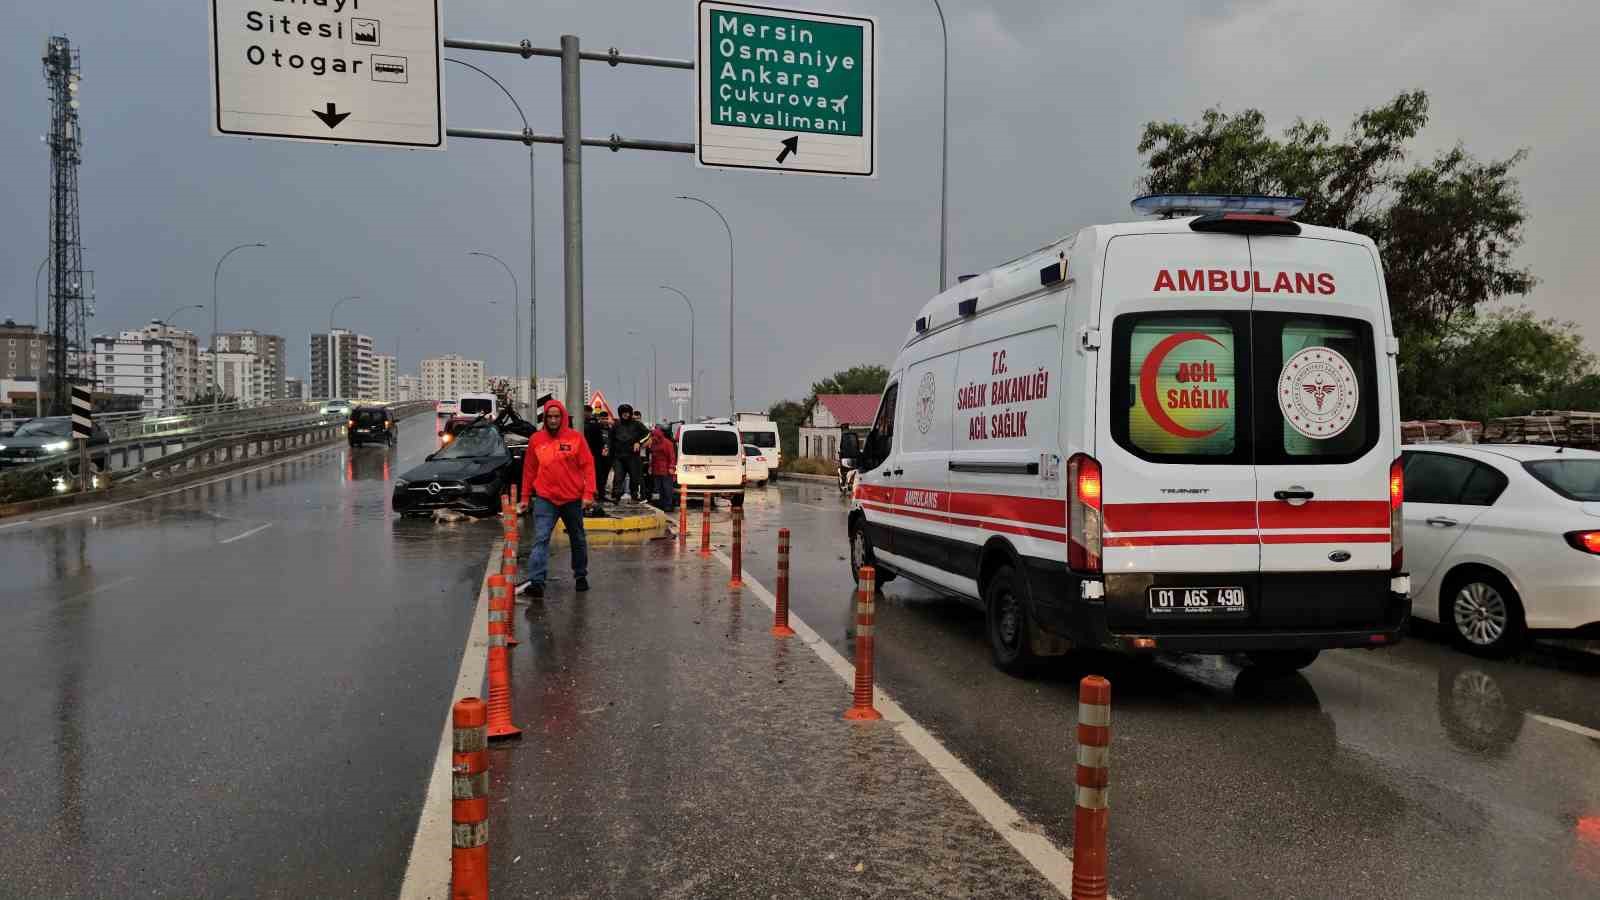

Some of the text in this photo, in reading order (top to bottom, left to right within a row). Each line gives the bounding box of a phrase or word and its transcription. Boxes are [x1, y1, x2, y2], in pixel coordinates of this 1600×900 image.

[246, 11, 342, 39] Sitesi
[719, 15, 813, 44] Mersin
[246, 45, 363, 76] Otogar
[719, 38, 855, 73] Osmaniye
[720, 62, 819, 88] Ankara
[719, 84, 827, 108] Çukurova
[1153, 269, 1336, 295] AMBULANS
[991, 350, 1008, 376] T.C.
[1176, 360, 1217, 383] ACİL
[957, 382, 987, 410] SAĞLIK
[991, 366, 1049, 405] BAKANLIĞI
[1167, 385, 1229, 409] SAĞLIK
[969, 408, 1027, 440] ACİL SAĞLIK
[1159, 590, 1174, 607] 01
[1217, 589, 1242, 606] 490
